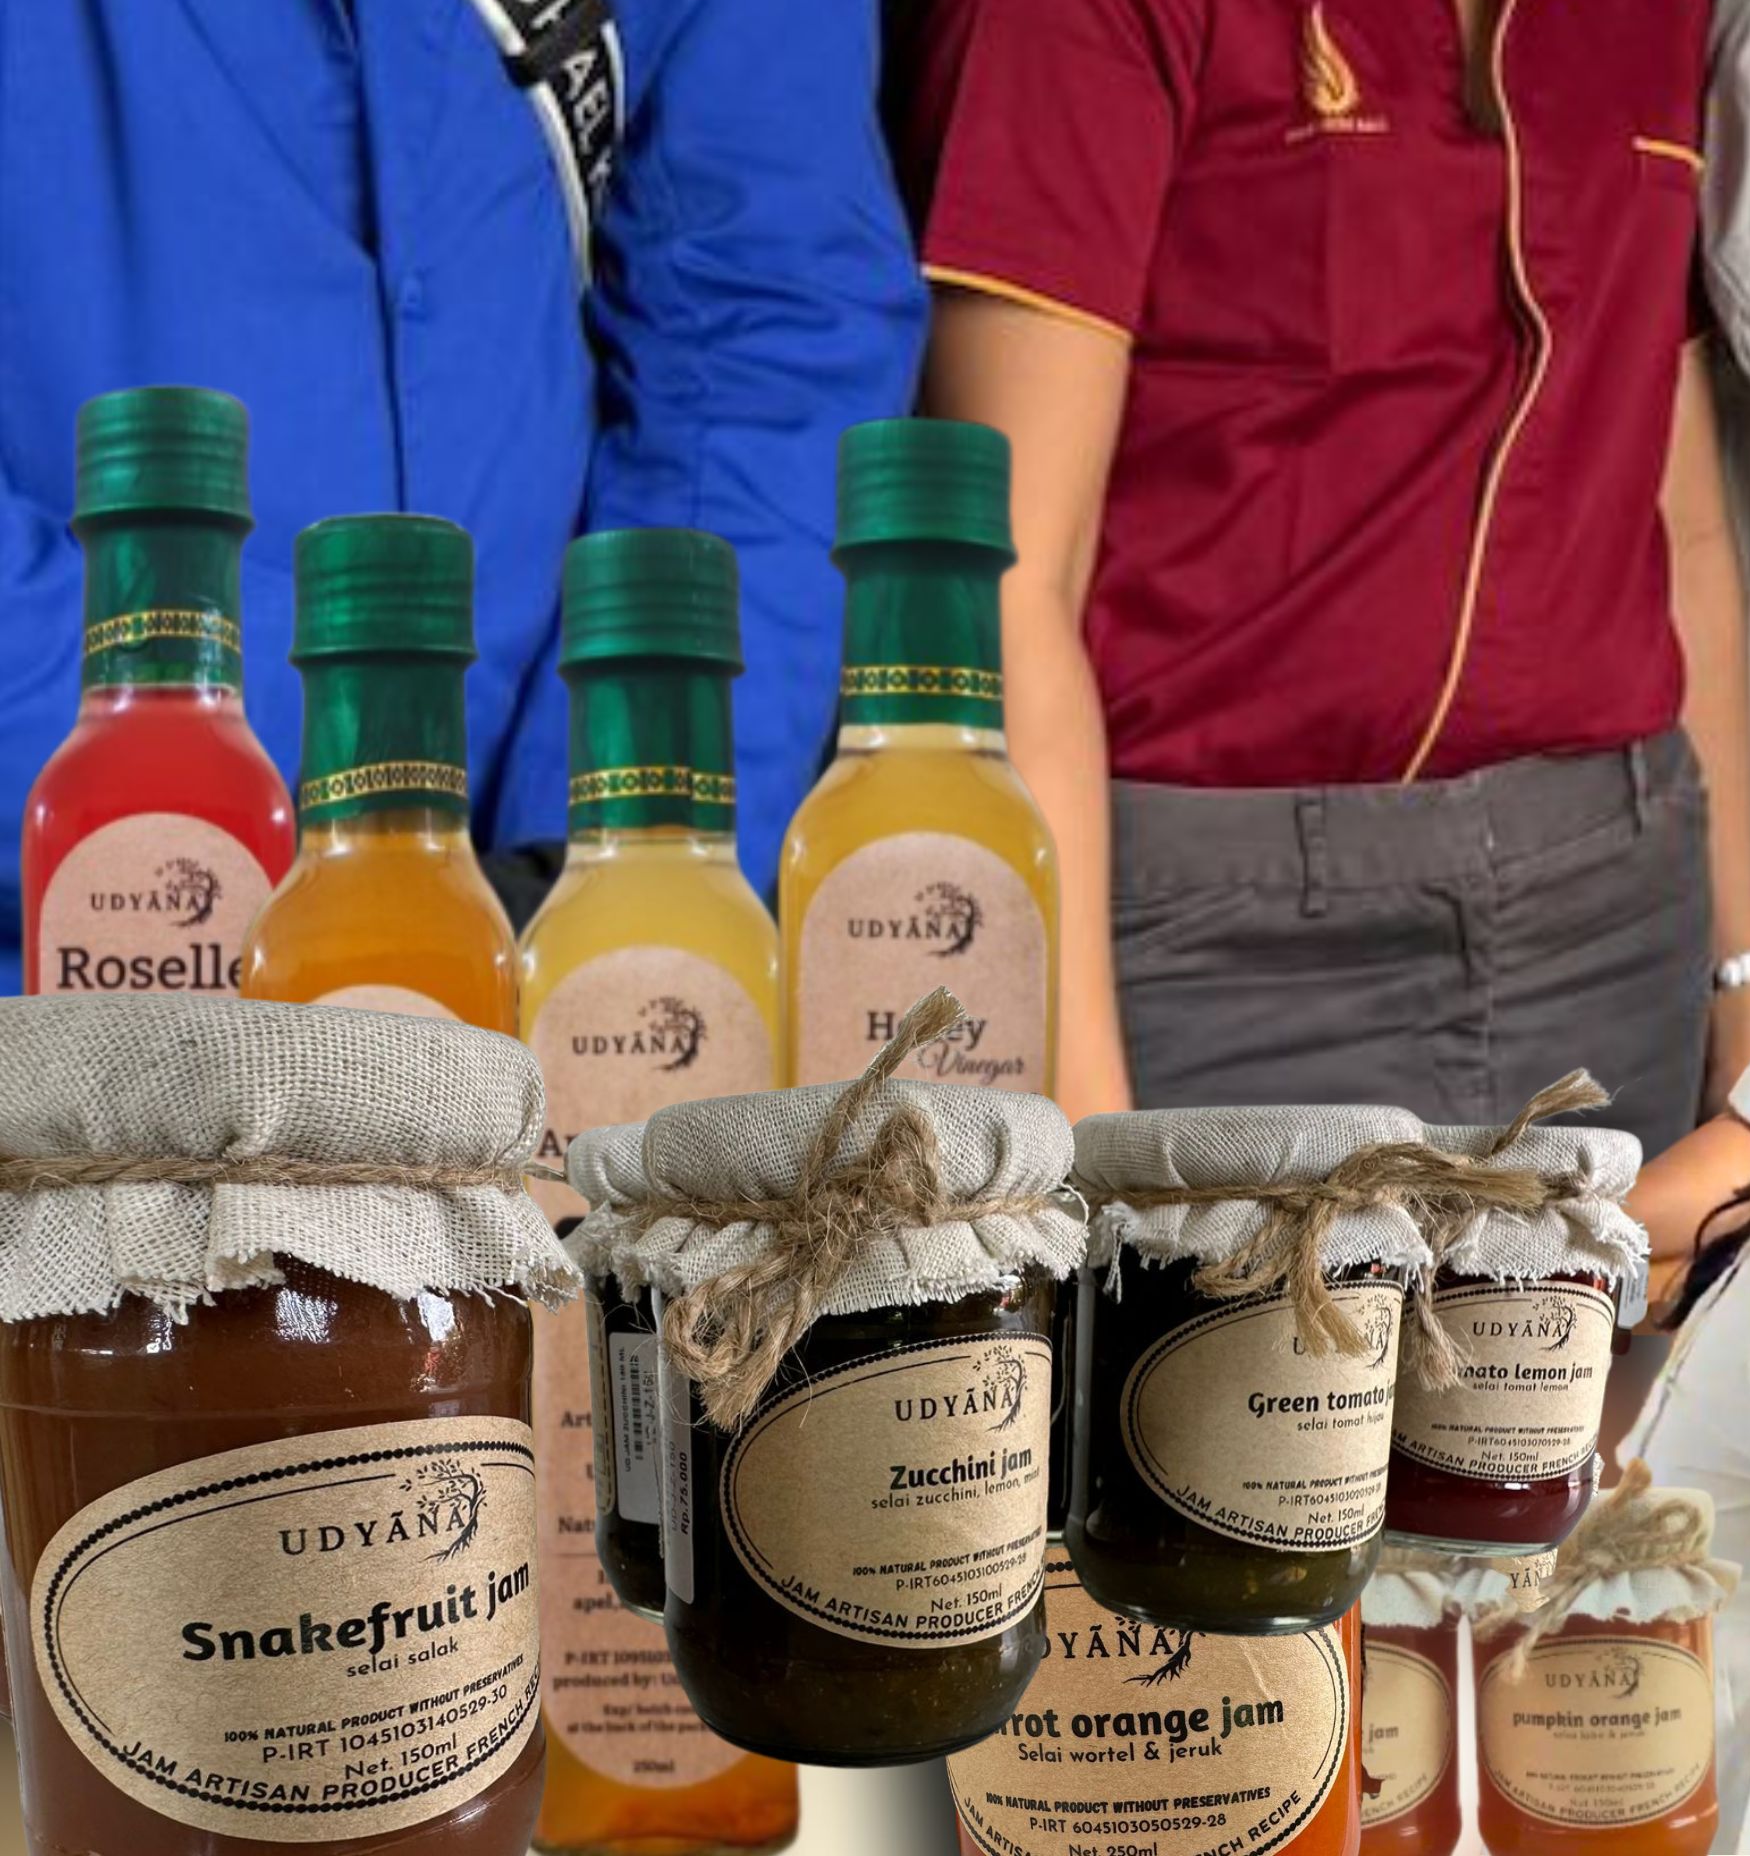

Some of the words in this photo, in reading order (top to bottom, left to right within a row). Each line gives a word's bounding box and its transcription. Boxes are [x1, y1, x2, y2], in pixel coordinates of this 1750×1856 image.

[1503, 1380, 1537, 1393] tomat
[1539, 1381, 1569, 1392] lemon
[1514, 1362, 1567, 1381] lemon
[1569, 1361, 1593, 1383] jam
[1247, 1391, 1319, 1419] Green
[1326, 1385, 1385, 1411] tomato
[1296, 1416, 1329, 1432] selai
[1331, 1414, 1365, 1430] tomat
[889, 1450, 997, 1491] Zucchini
[1000, 1447, 1033, 1481] jam
[1409, 1440, 1466, 1467] ARTISAN
[1468, 1458, 1539, 1475] PRODUCER
[679, 1451, 690, 1536] Rp.75.000
[870, 1492, 911, 1511] selai
[915, 1485, 982, 1507] zucchini,
[1176, 1484, 1213, 1512] JAM
[1214, 1507, 1289, 1538] ARTISAN
[1293, 1518, 1364, 1541] PRODUCER
[1338, 1503, 1365, 1522] 150ml
[879, 1561, 927, 1575] NATURAL
[929, 1553, 971, 1570] PRODUCT
[181, 1583, 479, 1662] Snakefruit
[485, 1560, 530, 1622] jam
[780, 1574, 821, 1604] JAM
[824, 1597, 909, 1630] ARTISAN
[915, 1604, 1004, 1630] PRODUCER
[930, 1597, 963, 1614] Net.
[965, 1582, 1003, 1607] 150ml
[346, 1650, 400, 1678] selai
[407, 1639, 460, 1666] salak
[223, 1727, 259, 1744] 100%
[263, 1719, 337, 1741] NATURAL
[340, 1705, 406, 1729] PRODUCT
[408, 1687, 461, 1715] WITHOUT
[462, 1653, 526, 1697] PRESERVATIVES
[1070, 1705, 1209, 1744] orange
[1219, 1695, 1285, 1740] jam
[1368, 1724, 1400, 1742] jam
[1512, 1710, 1585, 1729] pumpkin
[1589, 1709, 1651, 1730] orange
[1653, 1706, 1682, 1726] jam
[121, 1740, 178, 1778] JAM
[183, 1766, 311, 1803] ARTISAN
[322, 1753, 461, 1802] PRODUCER
[465, 1699, 525, 1762] FRENCH
[262, 1737, 330, 1765] P-IRT
[343, 1757, 394, 1781] Net.
[400, 1732, 459, 1769] 150ml
[1018, 1743, 1063, 1763] Selai
[1069, 1742, 1136, 1764] wortel
[1143, 1743, 1160, 1760] &
[1169, 1738, 1223, 1765] jeruk
[985, 1792, 1004, 1805] 100%
[1004, 1794, 1052, 1813] NATURAL
[1053, 1800, 1109, 1814] PRODUCT
[1112, 1799, 1170, 1814] WITHOUT
[1172, 1786, 1272, 1811] PRESERVATIVES
[964, 1796, 985, 1828] JAM
[1247, 1789, 1303, 1844] RECIPE
[1028, 1817, 1067, 1834] P-IRT
[1072, 1813, 1228, 1835] 6045103050529-28
[1106, 1841, 1159, 1856] 250ml
